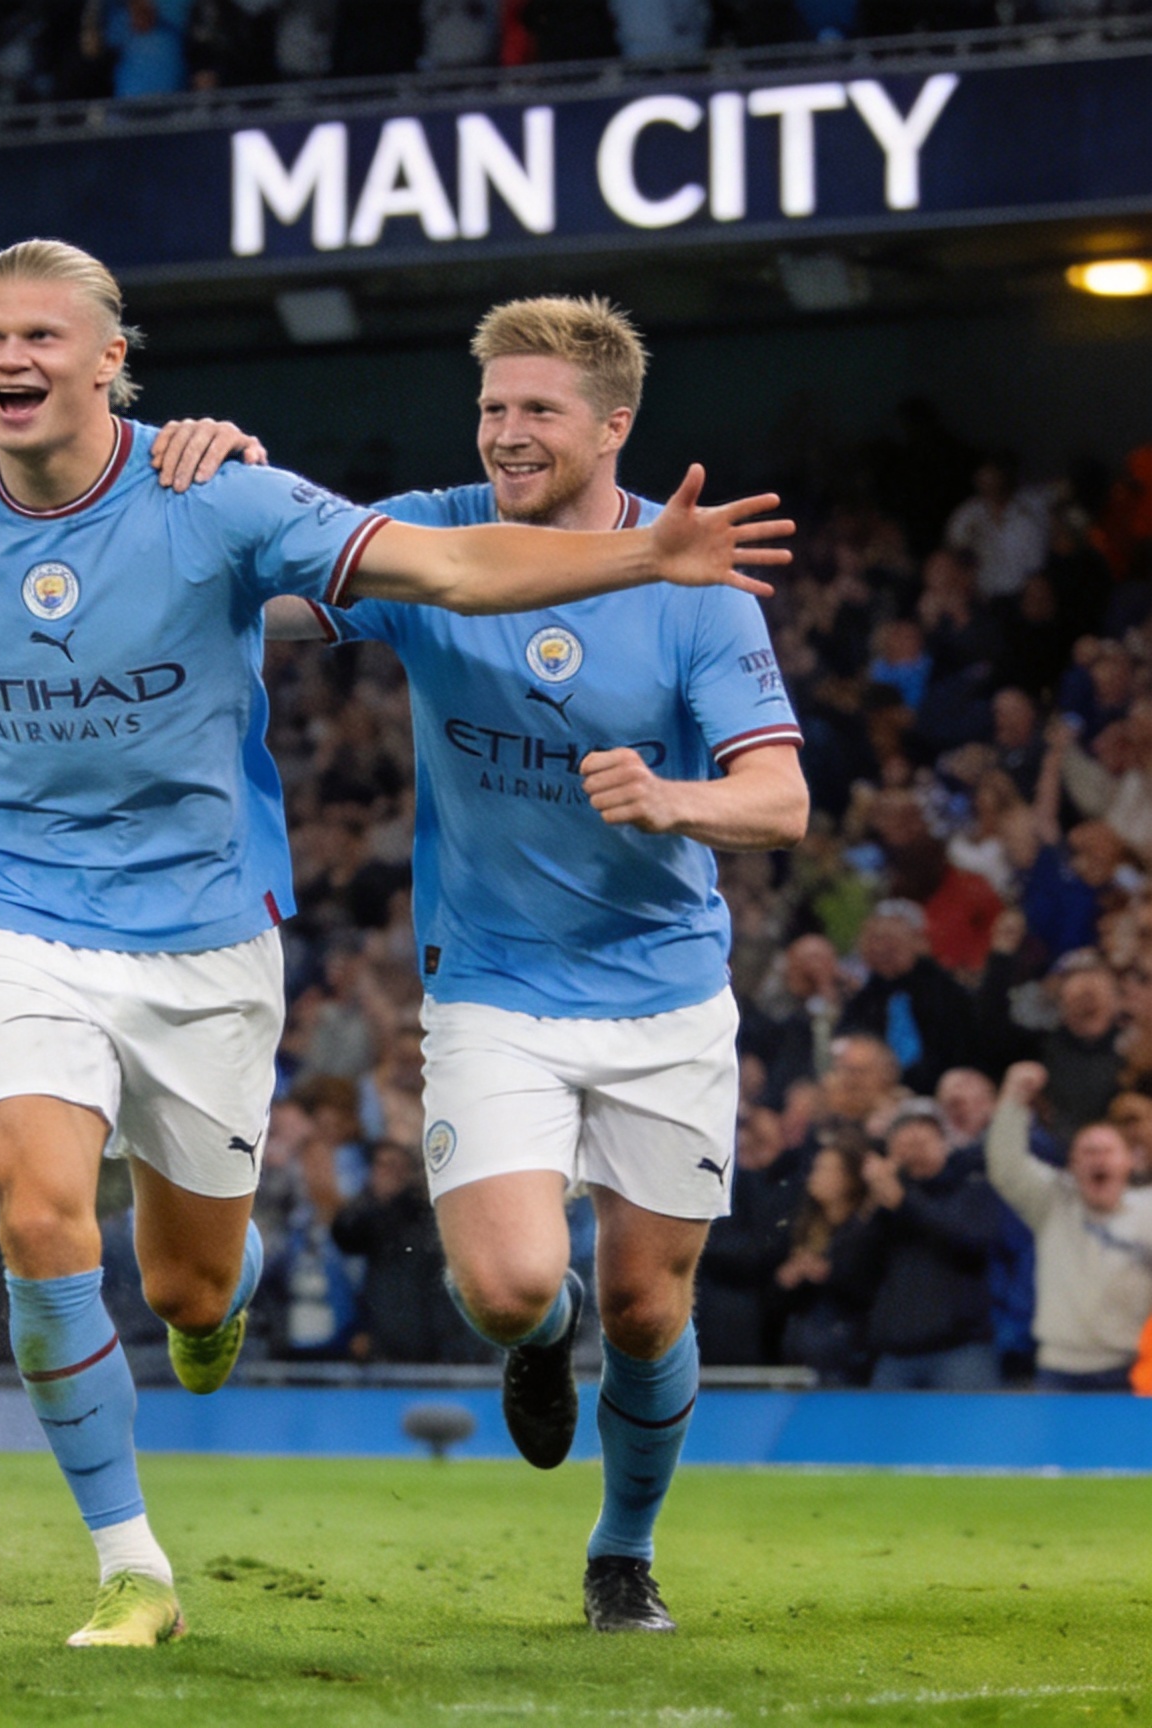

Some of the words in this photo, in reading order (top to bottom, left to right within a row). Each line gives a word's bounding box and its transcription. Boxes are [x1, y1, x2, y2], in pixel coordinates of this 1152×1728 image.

[231, 104, 555, 256] MAN
[596, 73, 959, 229] CITY
[445, 718, 666, 774] ETIHD
